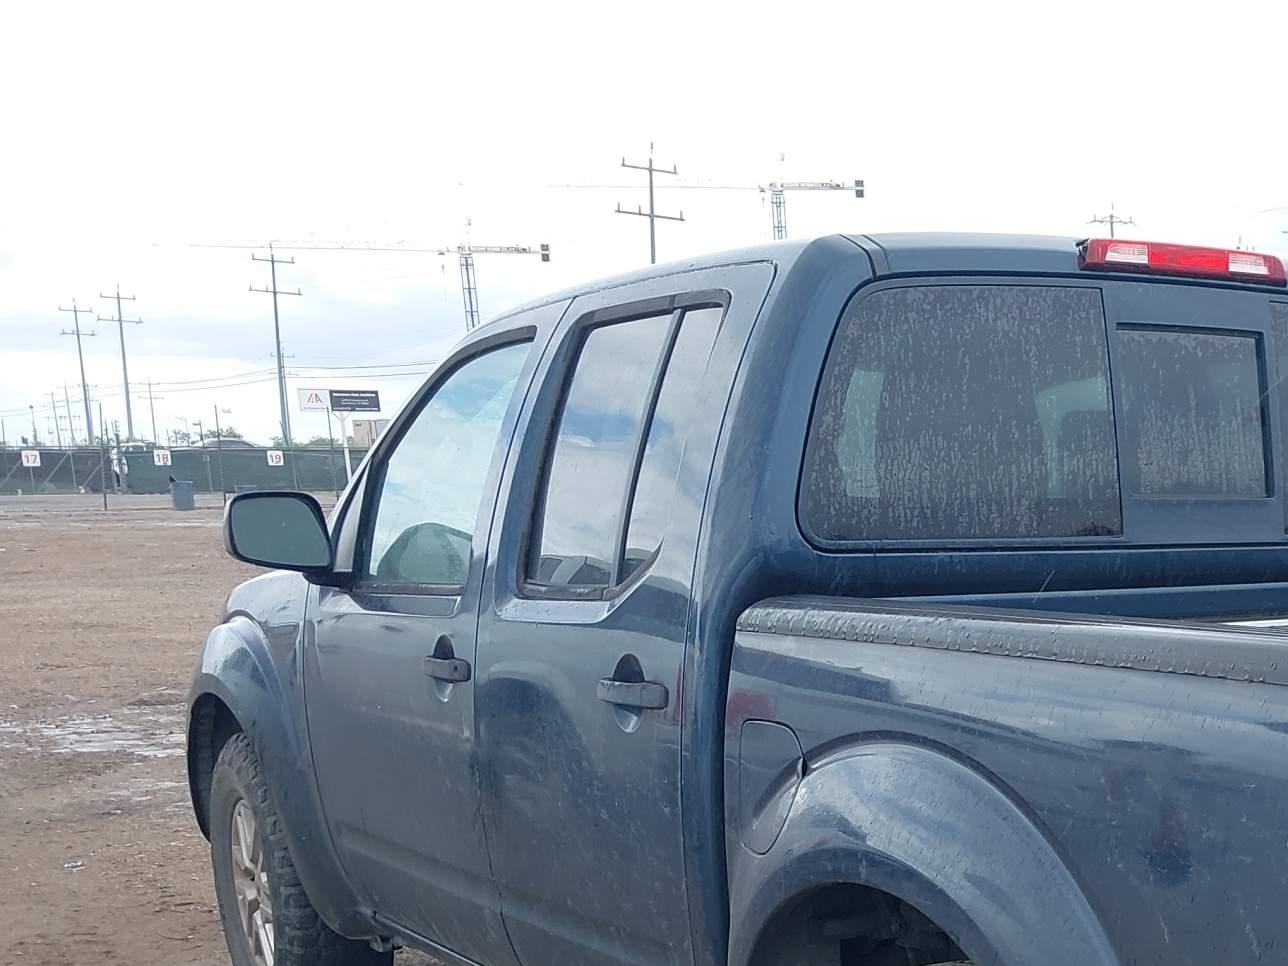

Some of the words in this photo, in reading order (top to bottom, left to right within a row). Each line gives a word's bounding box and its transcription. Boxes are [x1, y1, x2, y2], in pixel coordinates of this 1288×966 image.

[23, 454, 38, 464] 17
[156, 454, 169, 463] 18
[269, 454, 281, 463] 19
